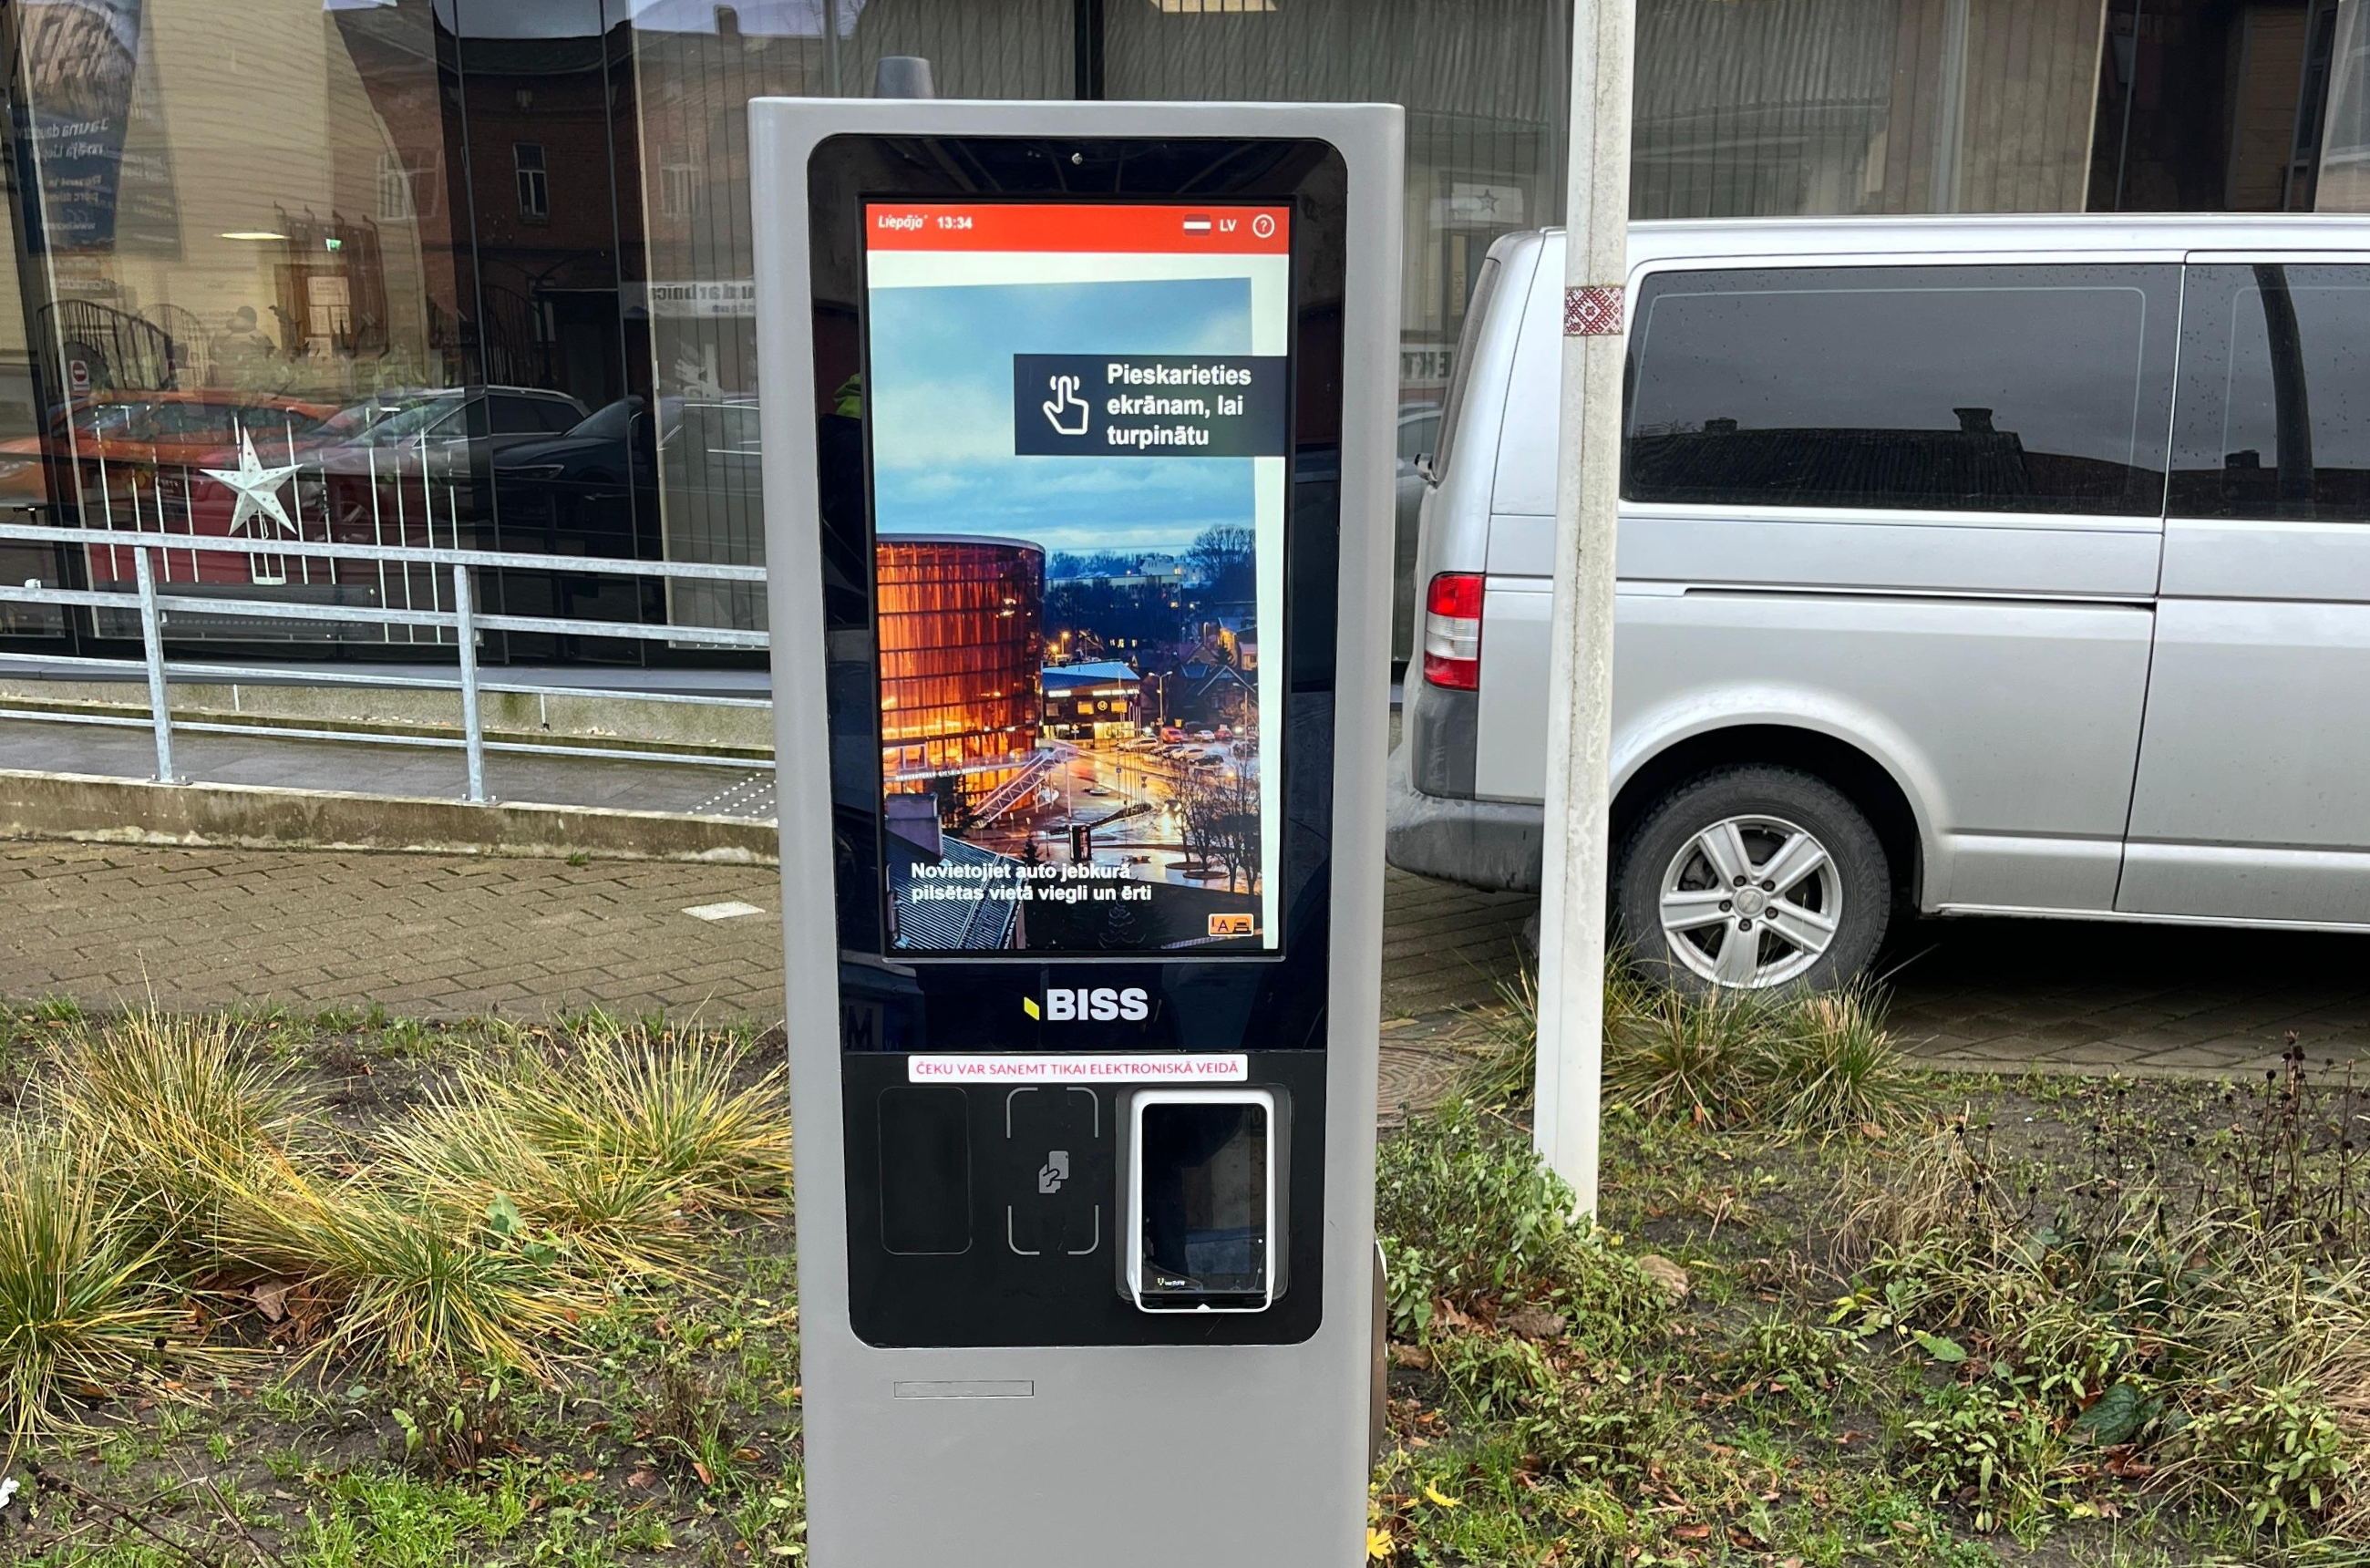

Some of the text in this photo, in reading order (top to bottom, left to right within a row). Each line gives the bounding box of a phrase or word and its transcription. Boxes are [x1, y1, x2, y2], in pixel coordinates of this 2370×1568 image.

[936, 216, 974, 230] 13:34
[1220, 219, 1237, 232] LV
[1108, 363, 1252, 387] Pieskarieties
[1107, 395, 1244, 419] ekrānam, lai
[1107, 425, 1210, 449] turpinātu
[912, 863, 1131, 881] Novietojiet auto jebkurā
[912, 885, 1152, 903] pilsētas vietā viegli un ērti
[1046, 987, 1149, 1021] BISS
[916, 1061, 954, 1076] ČEKU
[957, 1063, 986, 1076] VAR
[1051, 1063, 1087, 1075] TIKAI
[1089, 1061, 1193, 1075] ELEKTRONISKĀ
[1196, 1060, 1239, 1074] VEIDĀ
